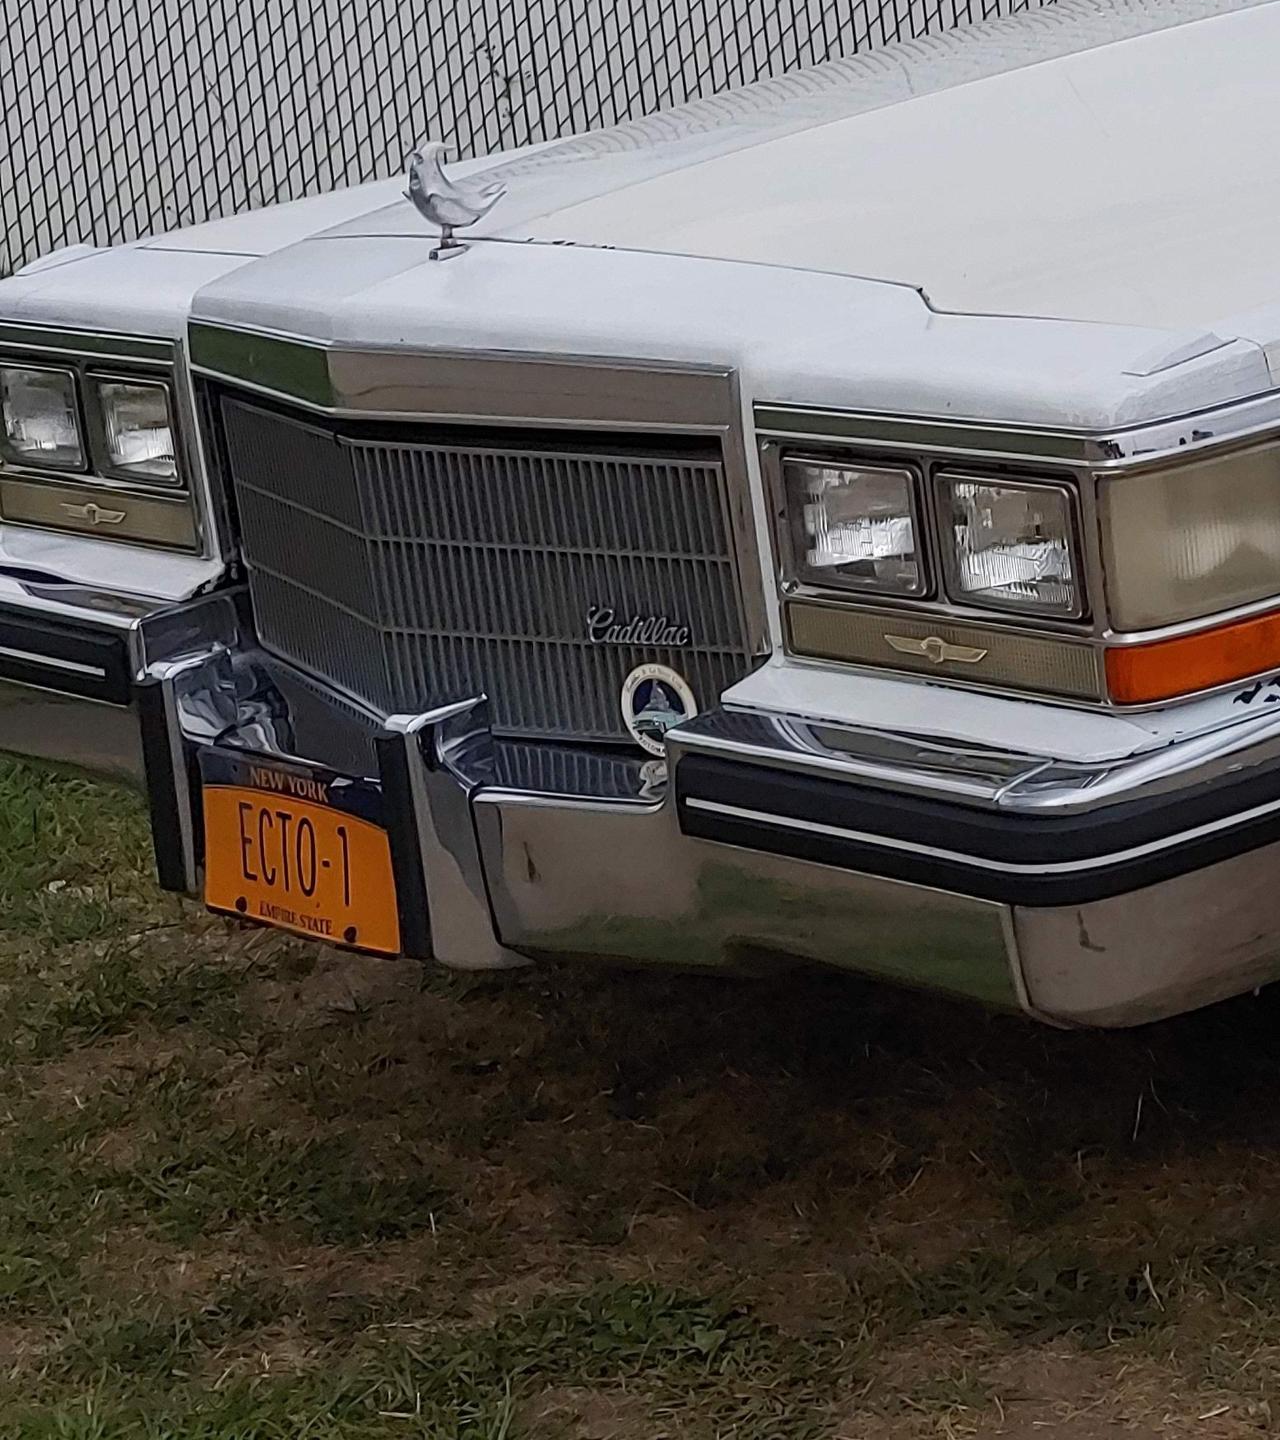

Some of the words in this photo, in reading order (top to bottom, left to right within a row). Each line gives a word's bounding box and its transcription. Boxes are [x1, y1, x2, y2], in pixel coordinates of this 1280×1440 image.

[586, 606, 688, 645] Cadillac
[250, 766, 286, 789] NEW
[288, 776, 329, 802] YORK
[238, 802, 351, 908] ECTO-1
[260, 900, 296, 924] EMPIRE
[299, 914, 333, 935] STATE
